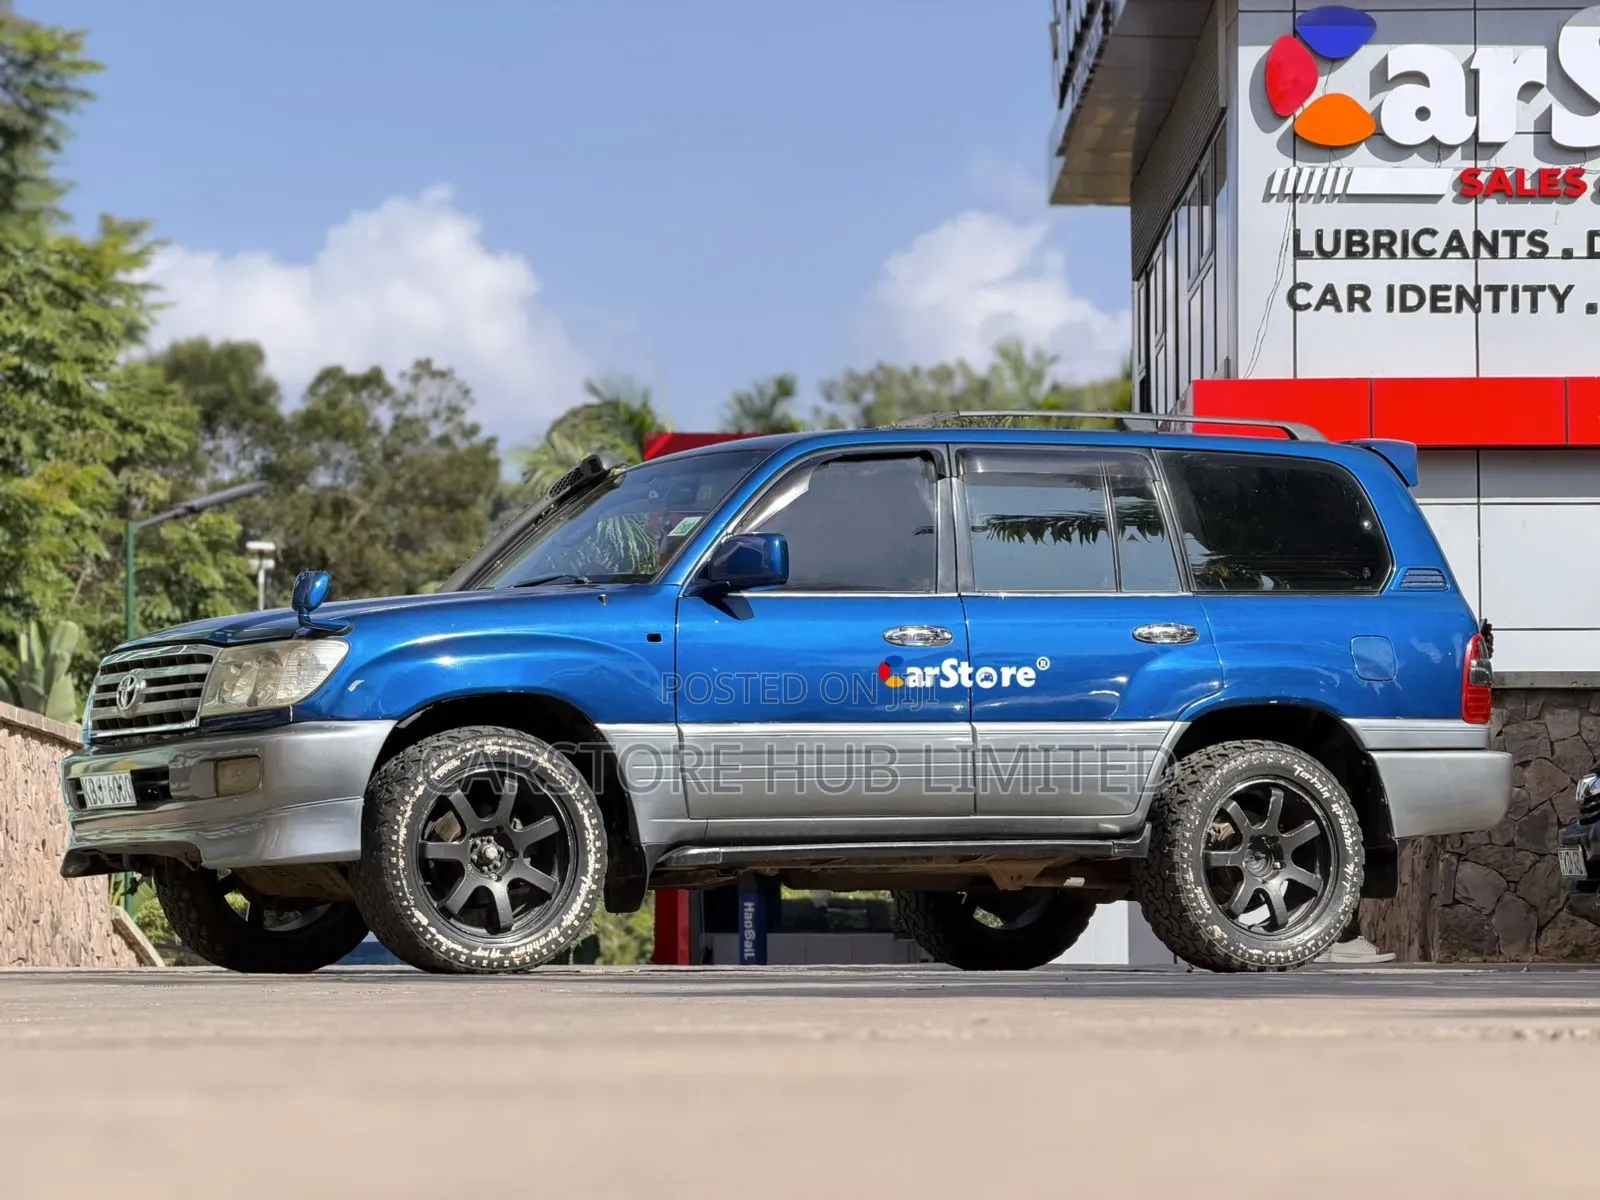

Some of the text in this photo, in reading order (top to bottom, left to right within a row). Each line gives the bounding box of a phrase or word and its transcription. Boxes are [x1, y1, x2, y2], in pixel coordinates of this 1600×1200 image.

[1459, 167, 1588, 198] SALES
[1294, 228, 1549, 259] LUBRICANTS
[1286, 282, 1575, 314] CAR IDENTITY
